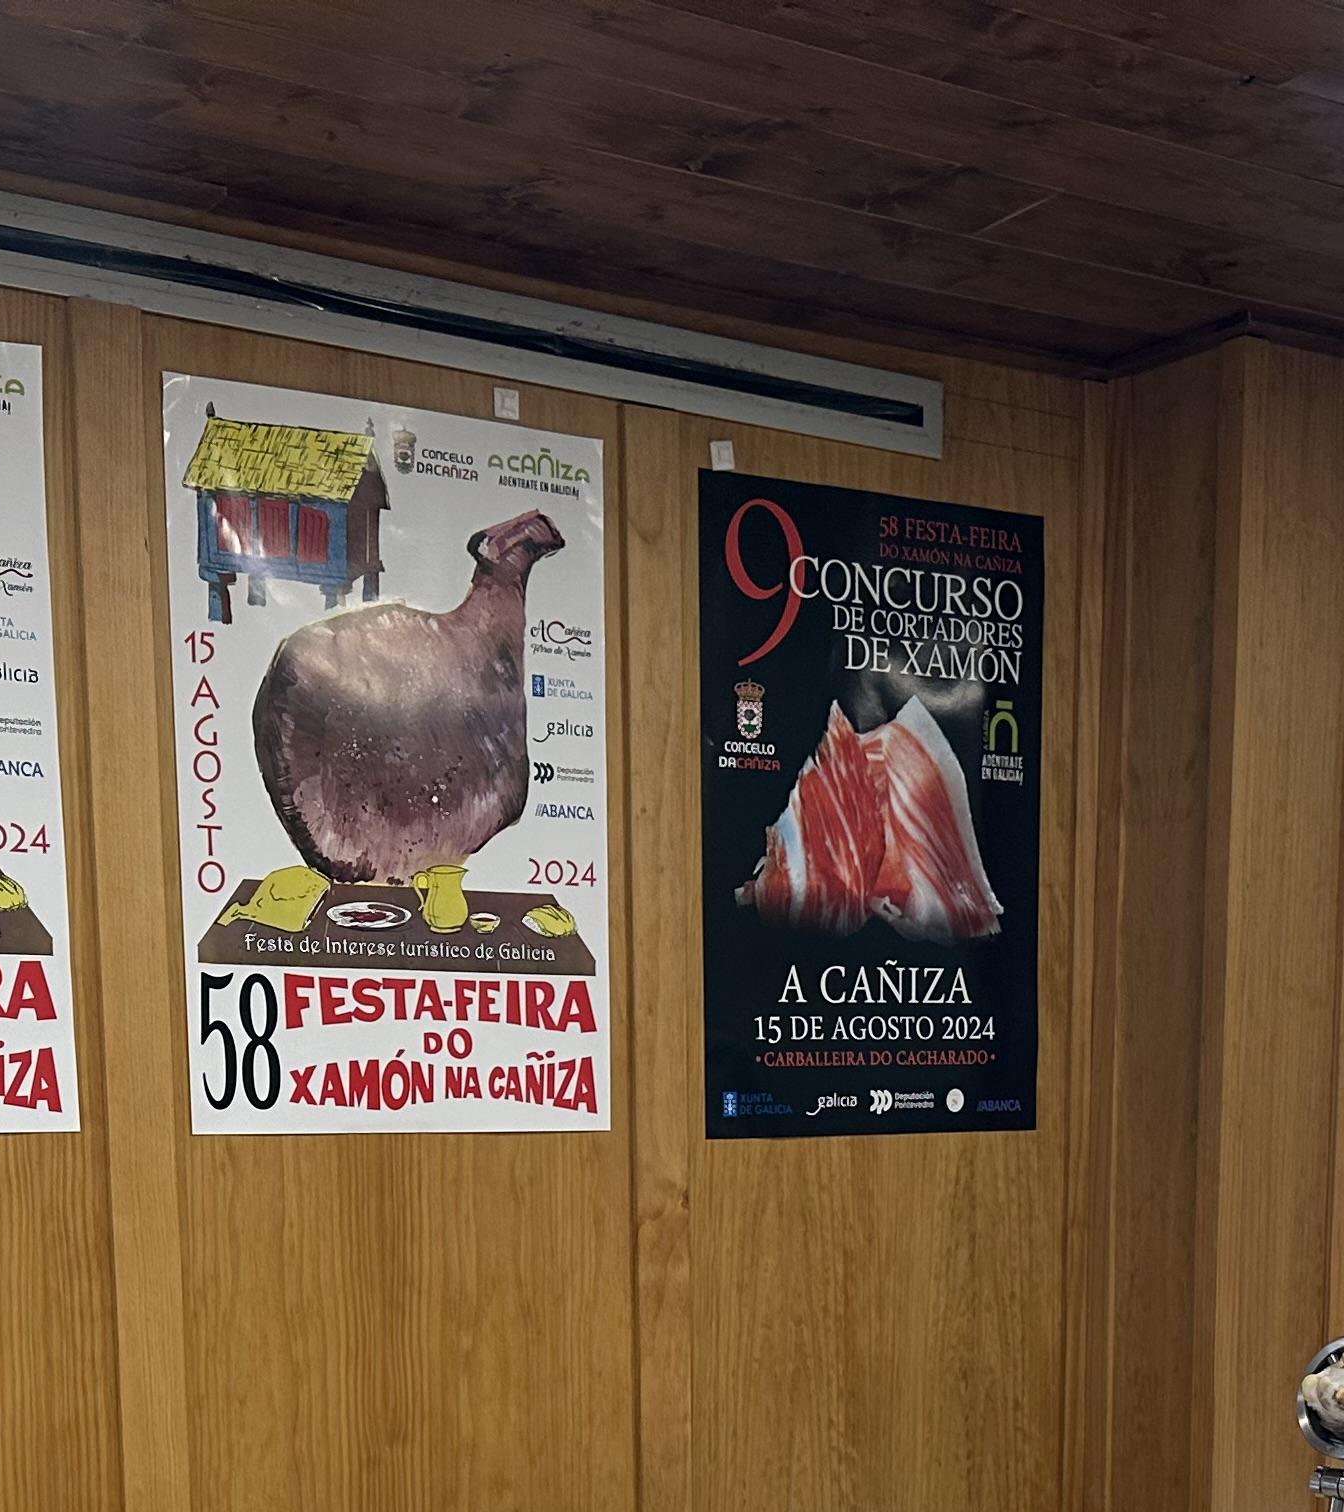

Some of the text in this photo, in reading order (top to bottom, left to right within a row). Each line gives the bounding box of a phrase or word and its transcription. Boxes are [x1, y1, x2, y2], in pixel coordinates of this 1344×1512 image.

[879, 515, 898, 539] 58
[725, 498, 805, 667] 9
[789, 555, 1024, 622] CONCURSO
[184, 630, 215, 664] 15
[832, 604, 1023, 650] DE CORTADORES
[844, 634, 1022, 685] DE XAMÓN
[527, 857, 597, 888] 2024
[778, 960, 972, 1004] A CAÑIZA
[199, 971, 598, 1111] 58 FESTA-FEIRA
[423, 1028, 473, 1060] DO
[754, 1015, 996, 1044] 15 DE AGOSTO 2024
[870, 1051, 893, 1066] DO
[289, 1049, 598, 1114] XAMÓN NA CAÑIZA
